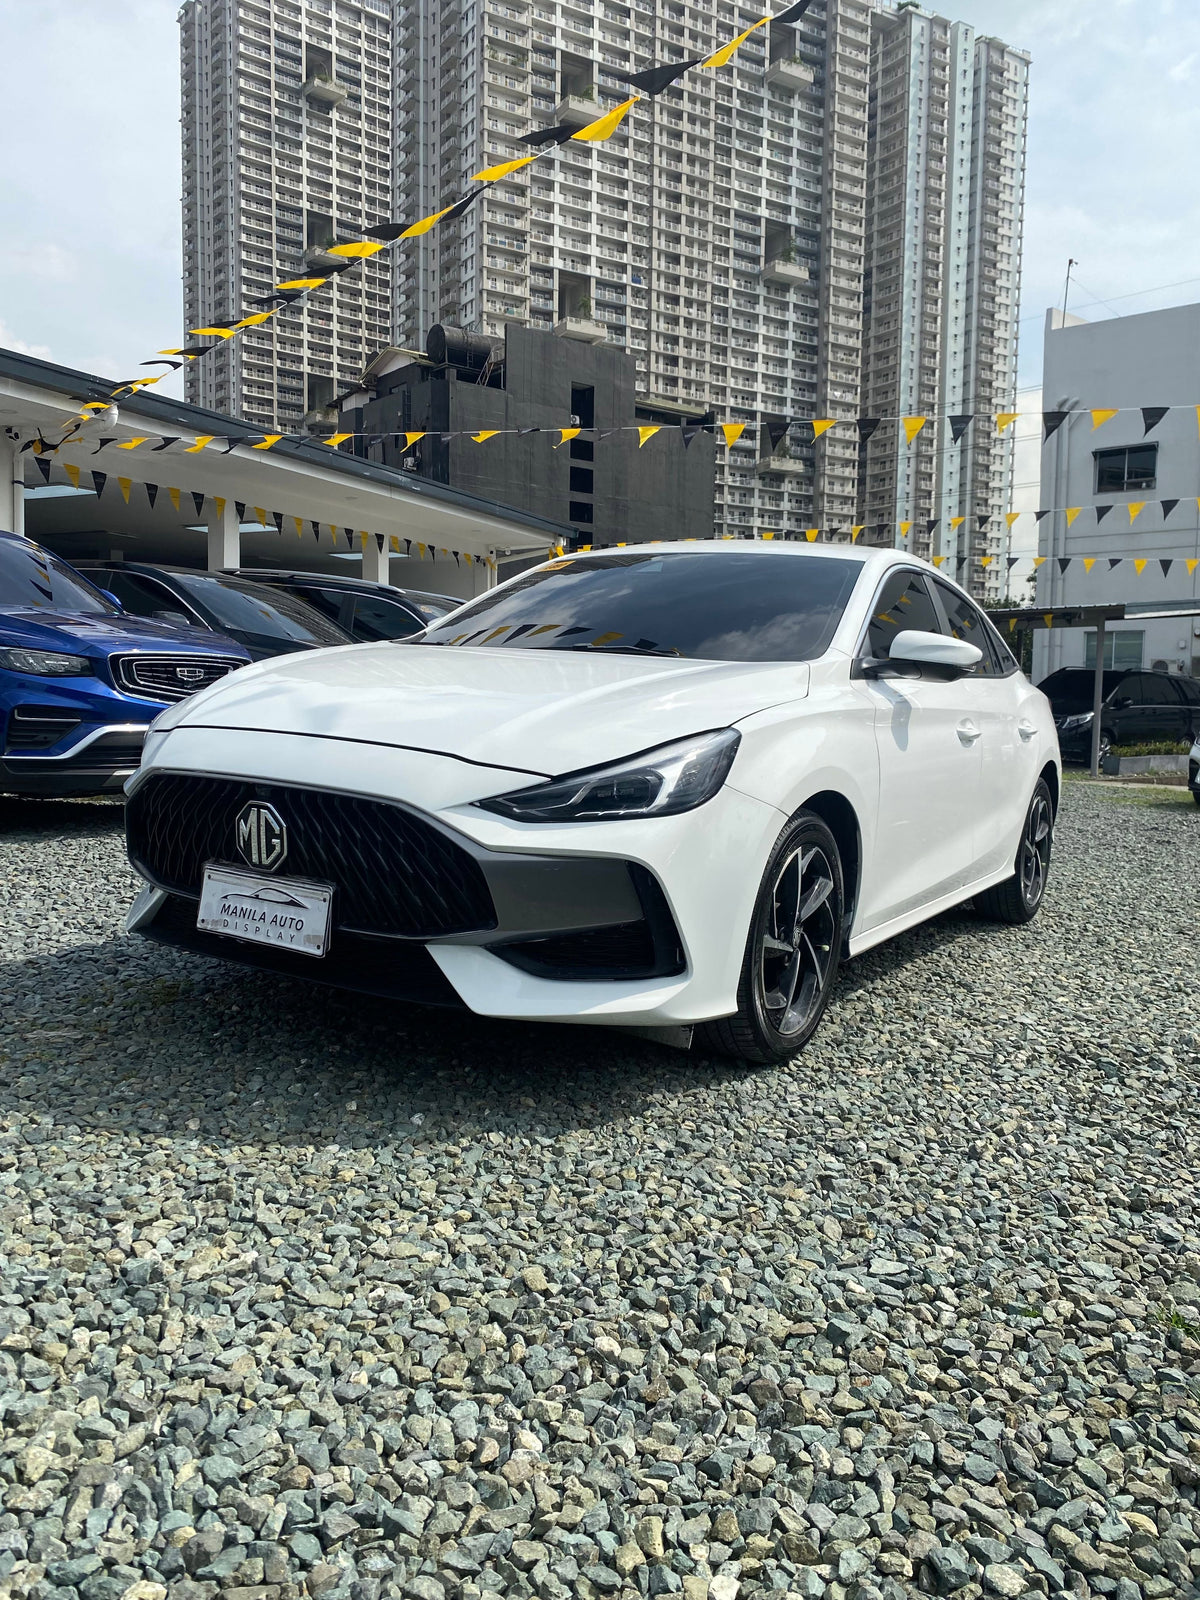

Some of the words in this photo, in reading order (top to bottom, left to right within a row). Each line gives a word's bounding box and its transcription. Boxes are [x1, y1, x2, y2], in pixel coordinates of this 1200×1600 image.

[239, 808, 280, 865] MG
[220, 903, 266, 923] MANILA
[270, 914, 304, 931] AUTO
[223, 918, 295, 942] DISPLAY
